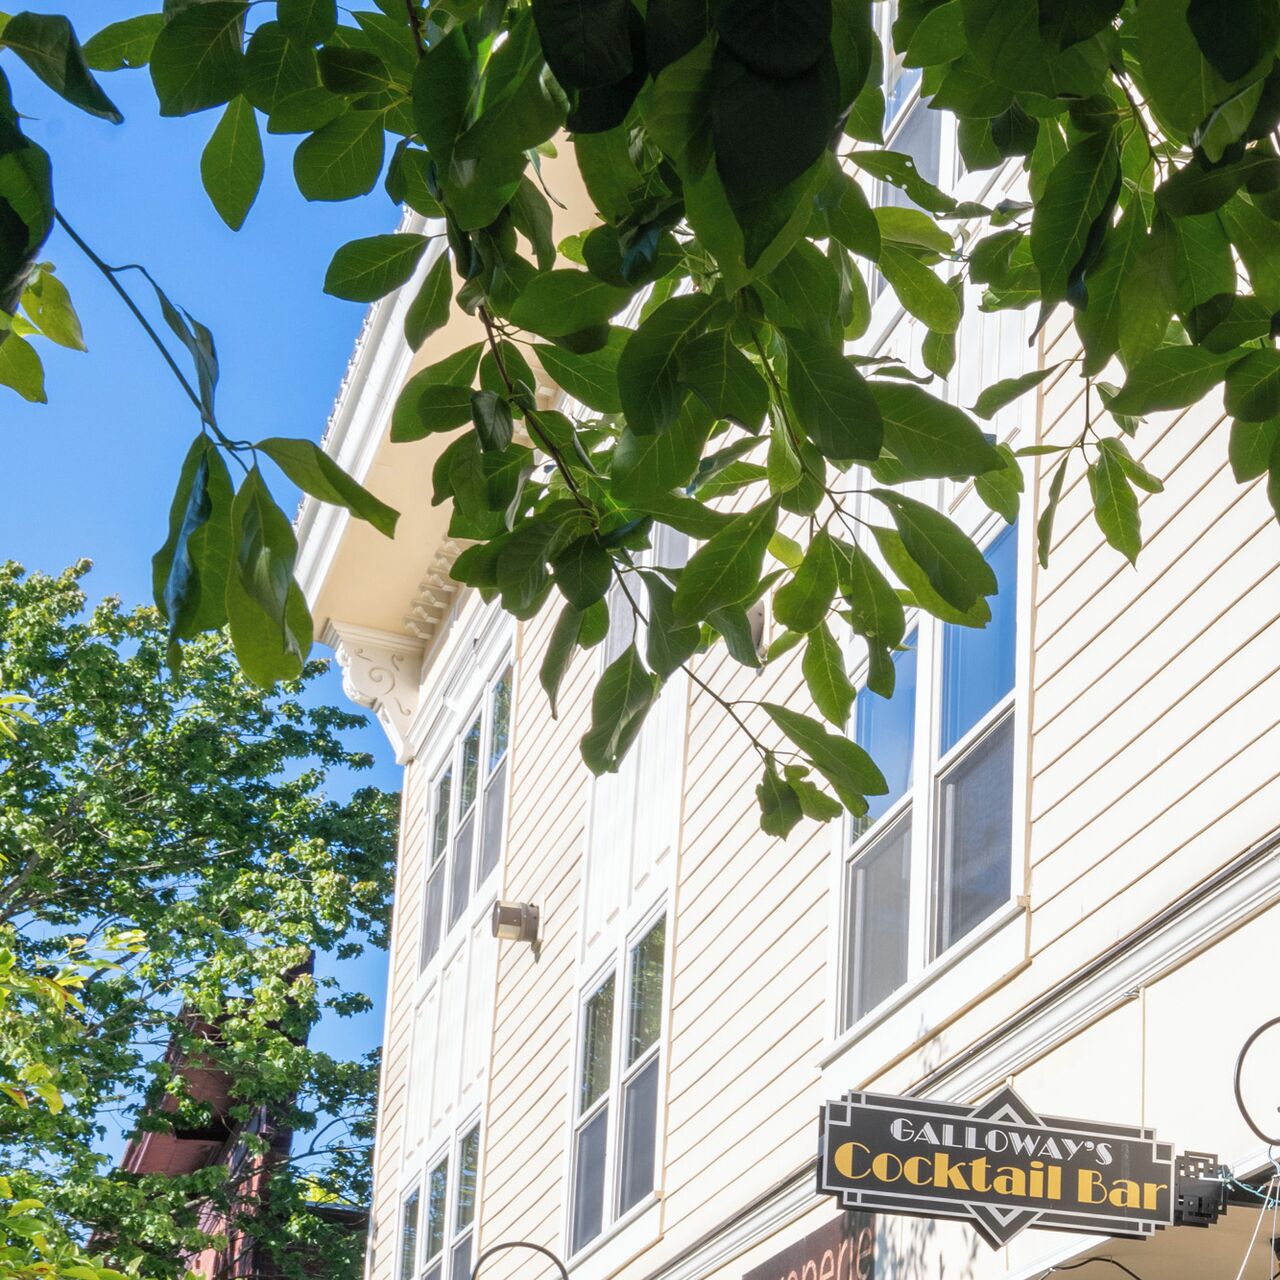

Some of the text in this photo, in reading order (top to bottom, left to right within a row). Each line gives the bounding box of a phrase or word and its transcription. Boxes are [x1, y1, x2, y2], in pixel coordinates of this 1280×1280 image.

[890, 1117, 1113, 1166] GALLOWAY'S
[834, 1141, 1168, 1211] Cocktail Bar
